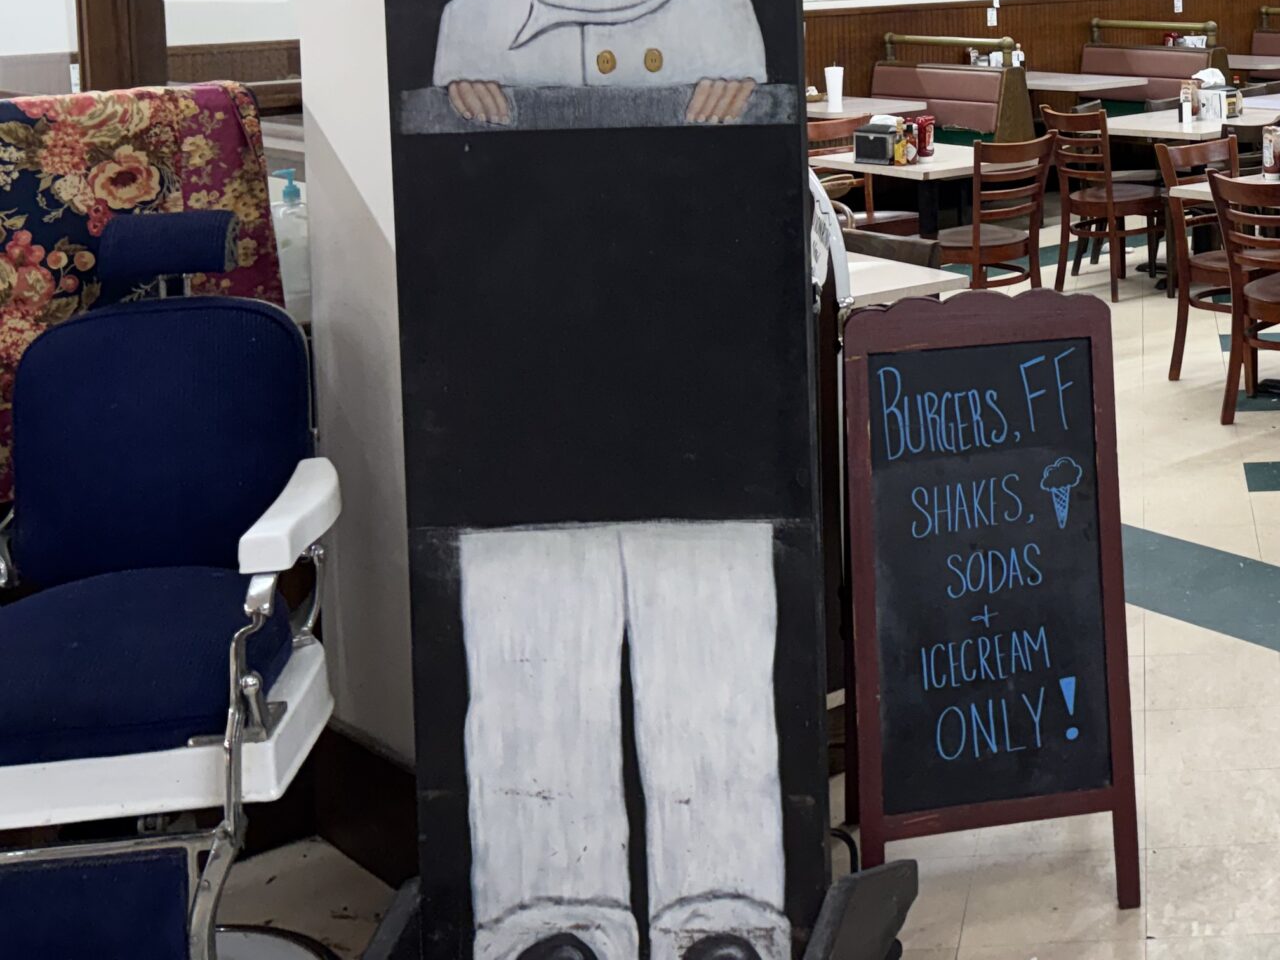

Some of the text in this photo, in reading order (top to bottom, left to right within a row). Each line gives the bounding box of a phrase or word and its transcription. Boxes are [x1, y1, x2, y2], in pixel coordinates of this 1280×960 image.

[877, 347, 1076, 460] BURGERS, FF
[911, 473, 1035, 538] SHAKES,
[946, 543, 1042, 599] SODAS
[920, 626, 1051, 691] ICECREAM
